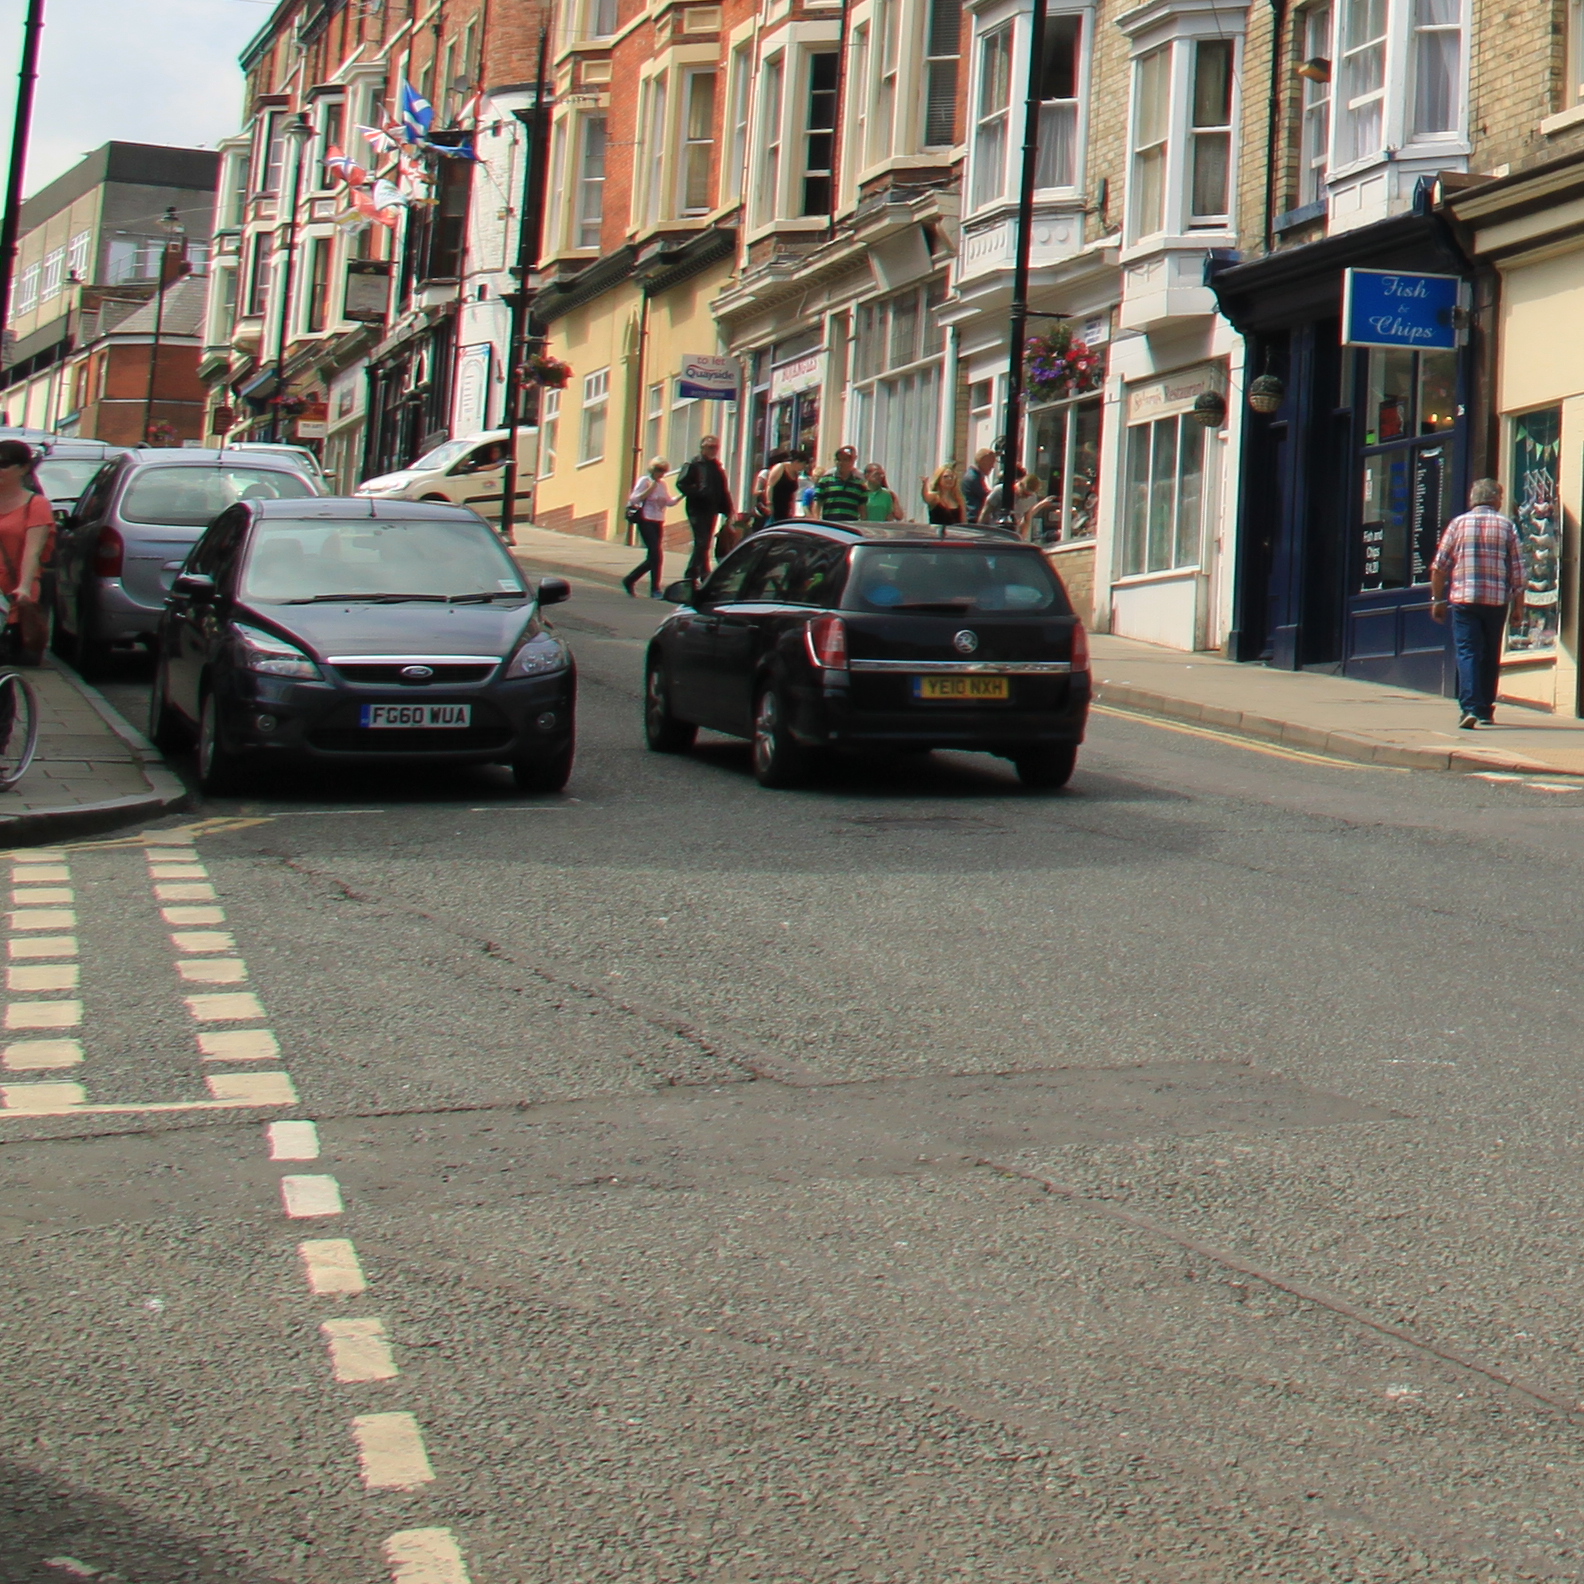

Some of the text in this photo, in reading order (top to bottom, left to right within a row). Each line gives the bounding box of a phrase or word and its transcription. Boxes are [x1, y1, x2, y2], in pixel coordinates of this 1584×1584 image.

[1381, 276, 1430, 298] Fish
[1397, 303, 1410, 313] &
[1369, 316, 1437, 343] Chips
[697, 357, 725, 365] to let
[686, 368, 734, 380] Quayside
[970, 679, 1003, 695] NXH
[373, 707, 466, 724] FG60 WUA
